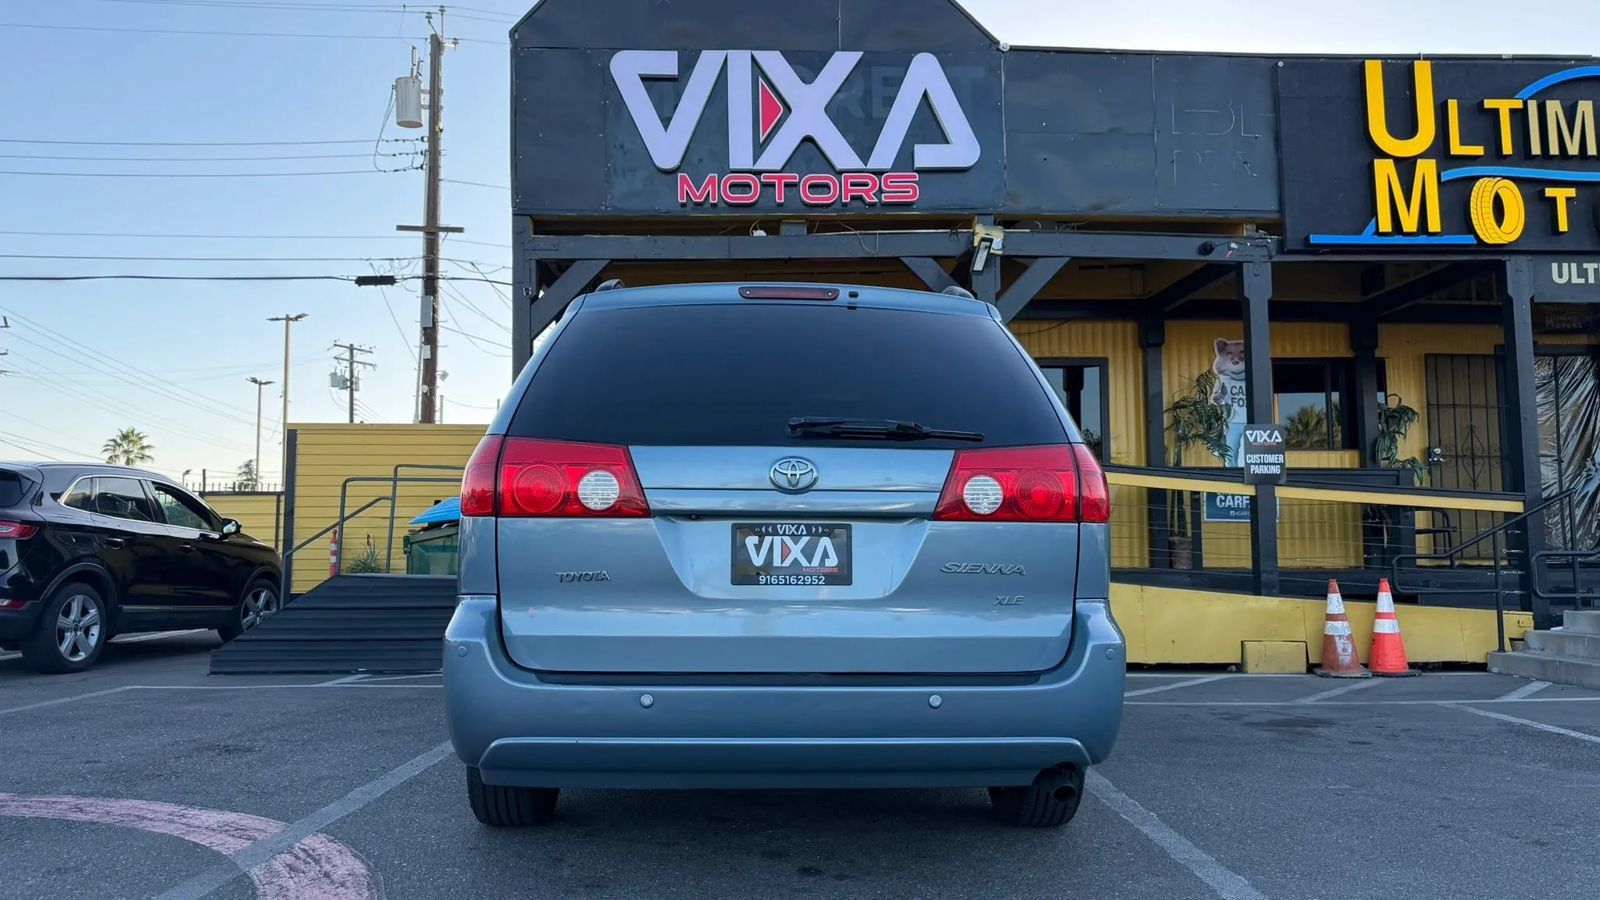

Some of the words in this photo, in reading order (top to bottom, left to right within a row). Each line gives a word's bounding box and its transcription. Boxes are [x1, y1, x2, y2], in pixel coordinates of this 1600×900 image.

[609, 49, 981, 172] VIXA
[1364, 59, 1598, 158] ULTIM
[676, 172, 921, 206] MOTORS
[1551, 262, 1600, 284] ULT
[1230, 397, 1248, 408] FO
[1245, 430, 1283, 443] VIXA
[1246, 453, 1284, 464] CUSTOMER
[1250, 465, 1281, 475] PARKING
[1216, 495, 1251, 508] CARF
[776, 524, 807, 535] VIXA
[745, 535, 839, 567] VIXA
[940, 562, 1027, 576] SIENNA
[555, 570, 610, 583] TOYOTA
[758, 575, 826, 585] 9165162952
[992, 595, 1025, 606] XLE
